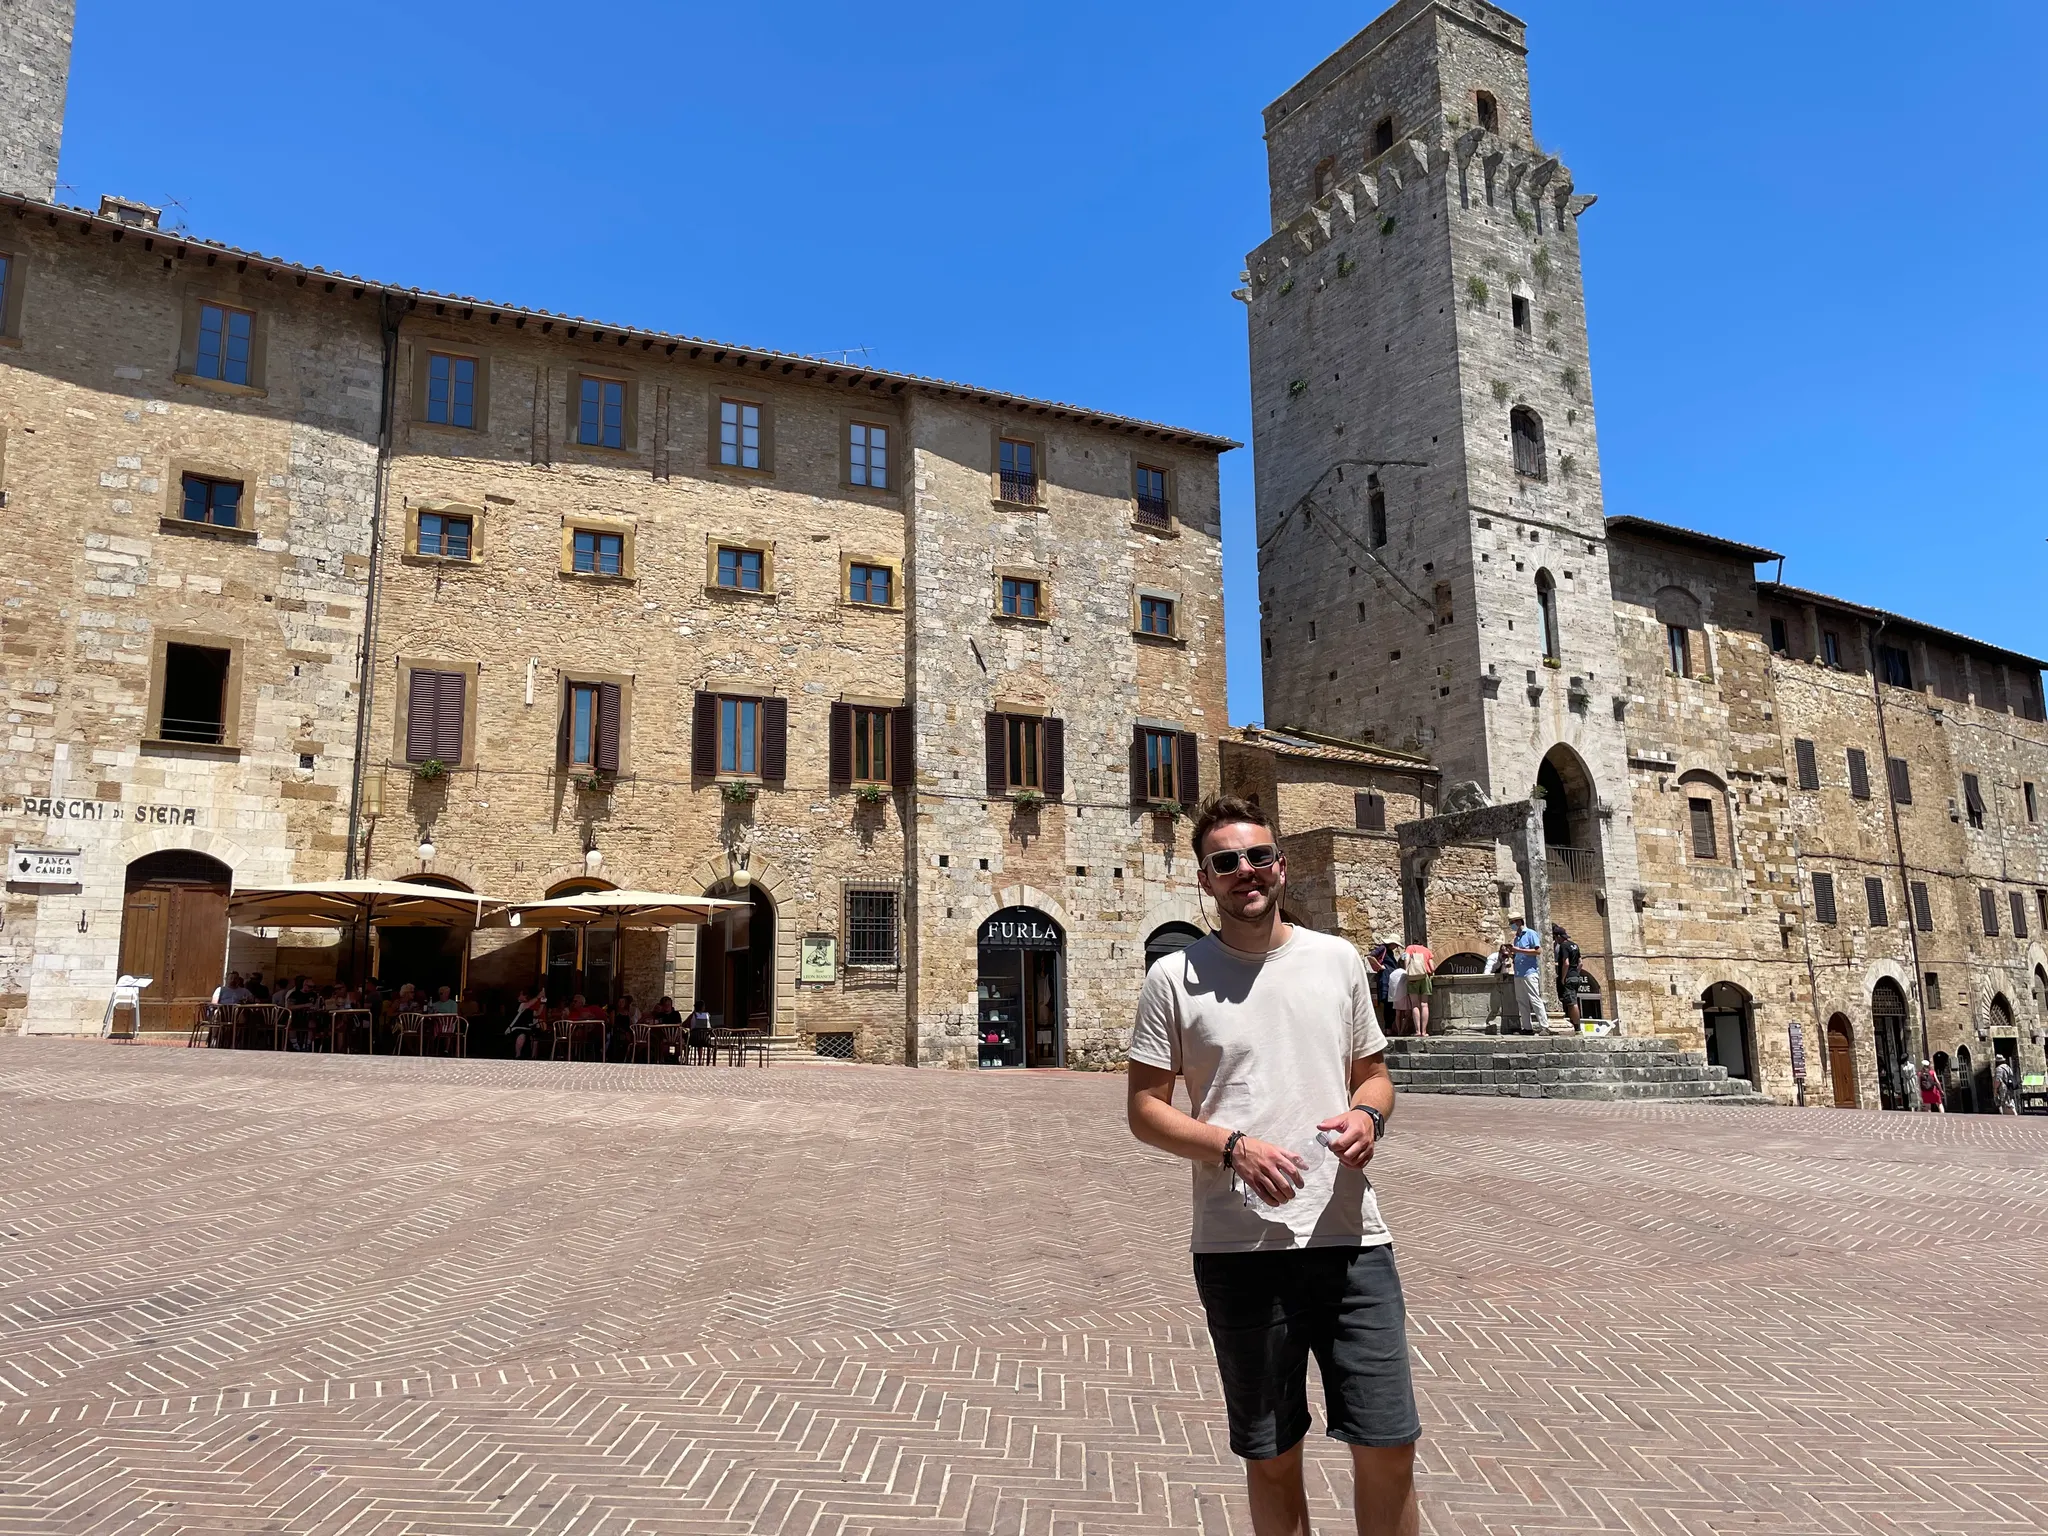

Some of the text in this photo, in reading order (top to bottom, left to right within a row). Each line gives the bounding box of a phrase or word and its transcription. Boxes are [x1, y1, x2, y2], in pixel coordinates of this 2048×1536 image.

[24, 797, 103, 820] PASCHI
[113, 808, 124, 819] DI
[134, 805, 196, 826] SIENA
[38, 856, 71, 866] BANCA
[35, 865, 72, 875] CAMBIO
[988, 921, 1057, 939] FURLA
